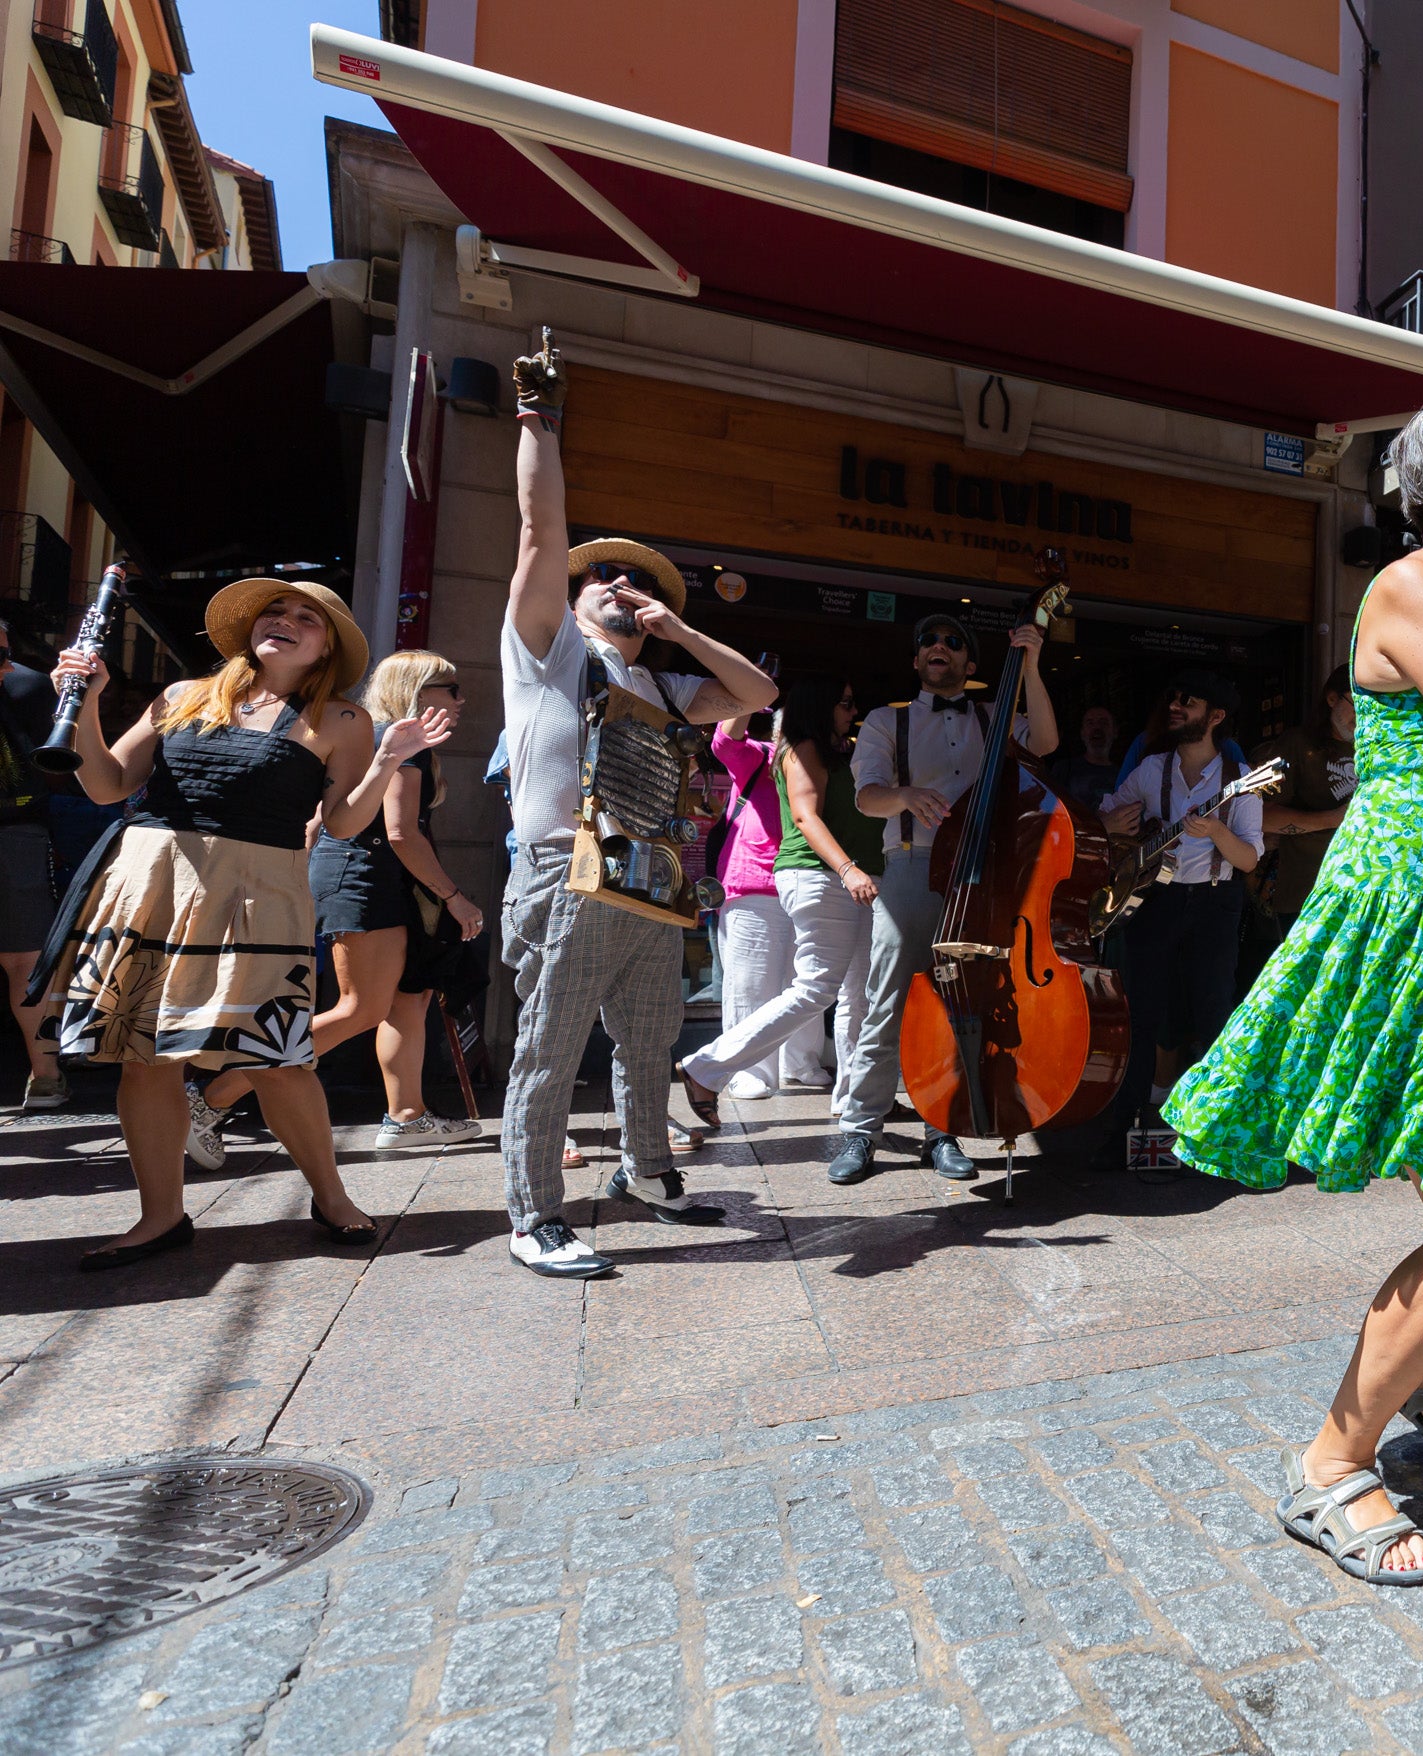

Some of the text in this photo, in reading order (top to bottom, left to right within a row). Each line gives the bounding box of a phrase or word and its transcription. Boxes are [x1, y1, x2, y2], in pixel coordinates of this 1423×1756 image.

[1267, 433, 1302, 447] ALARMA
[1266, 446, 1278, 456] 902
[1279, 449, 1286, 458] 57
[839, 445, 907, 508] la
[837, 512, 935, 543] TABERNA
[941, 528, 953, 543] Y
[958, 531, 1033, 555] TIENDA
[1073, 549, 1130, 571] VINOS
[823, 595, 851, 607] Choice
